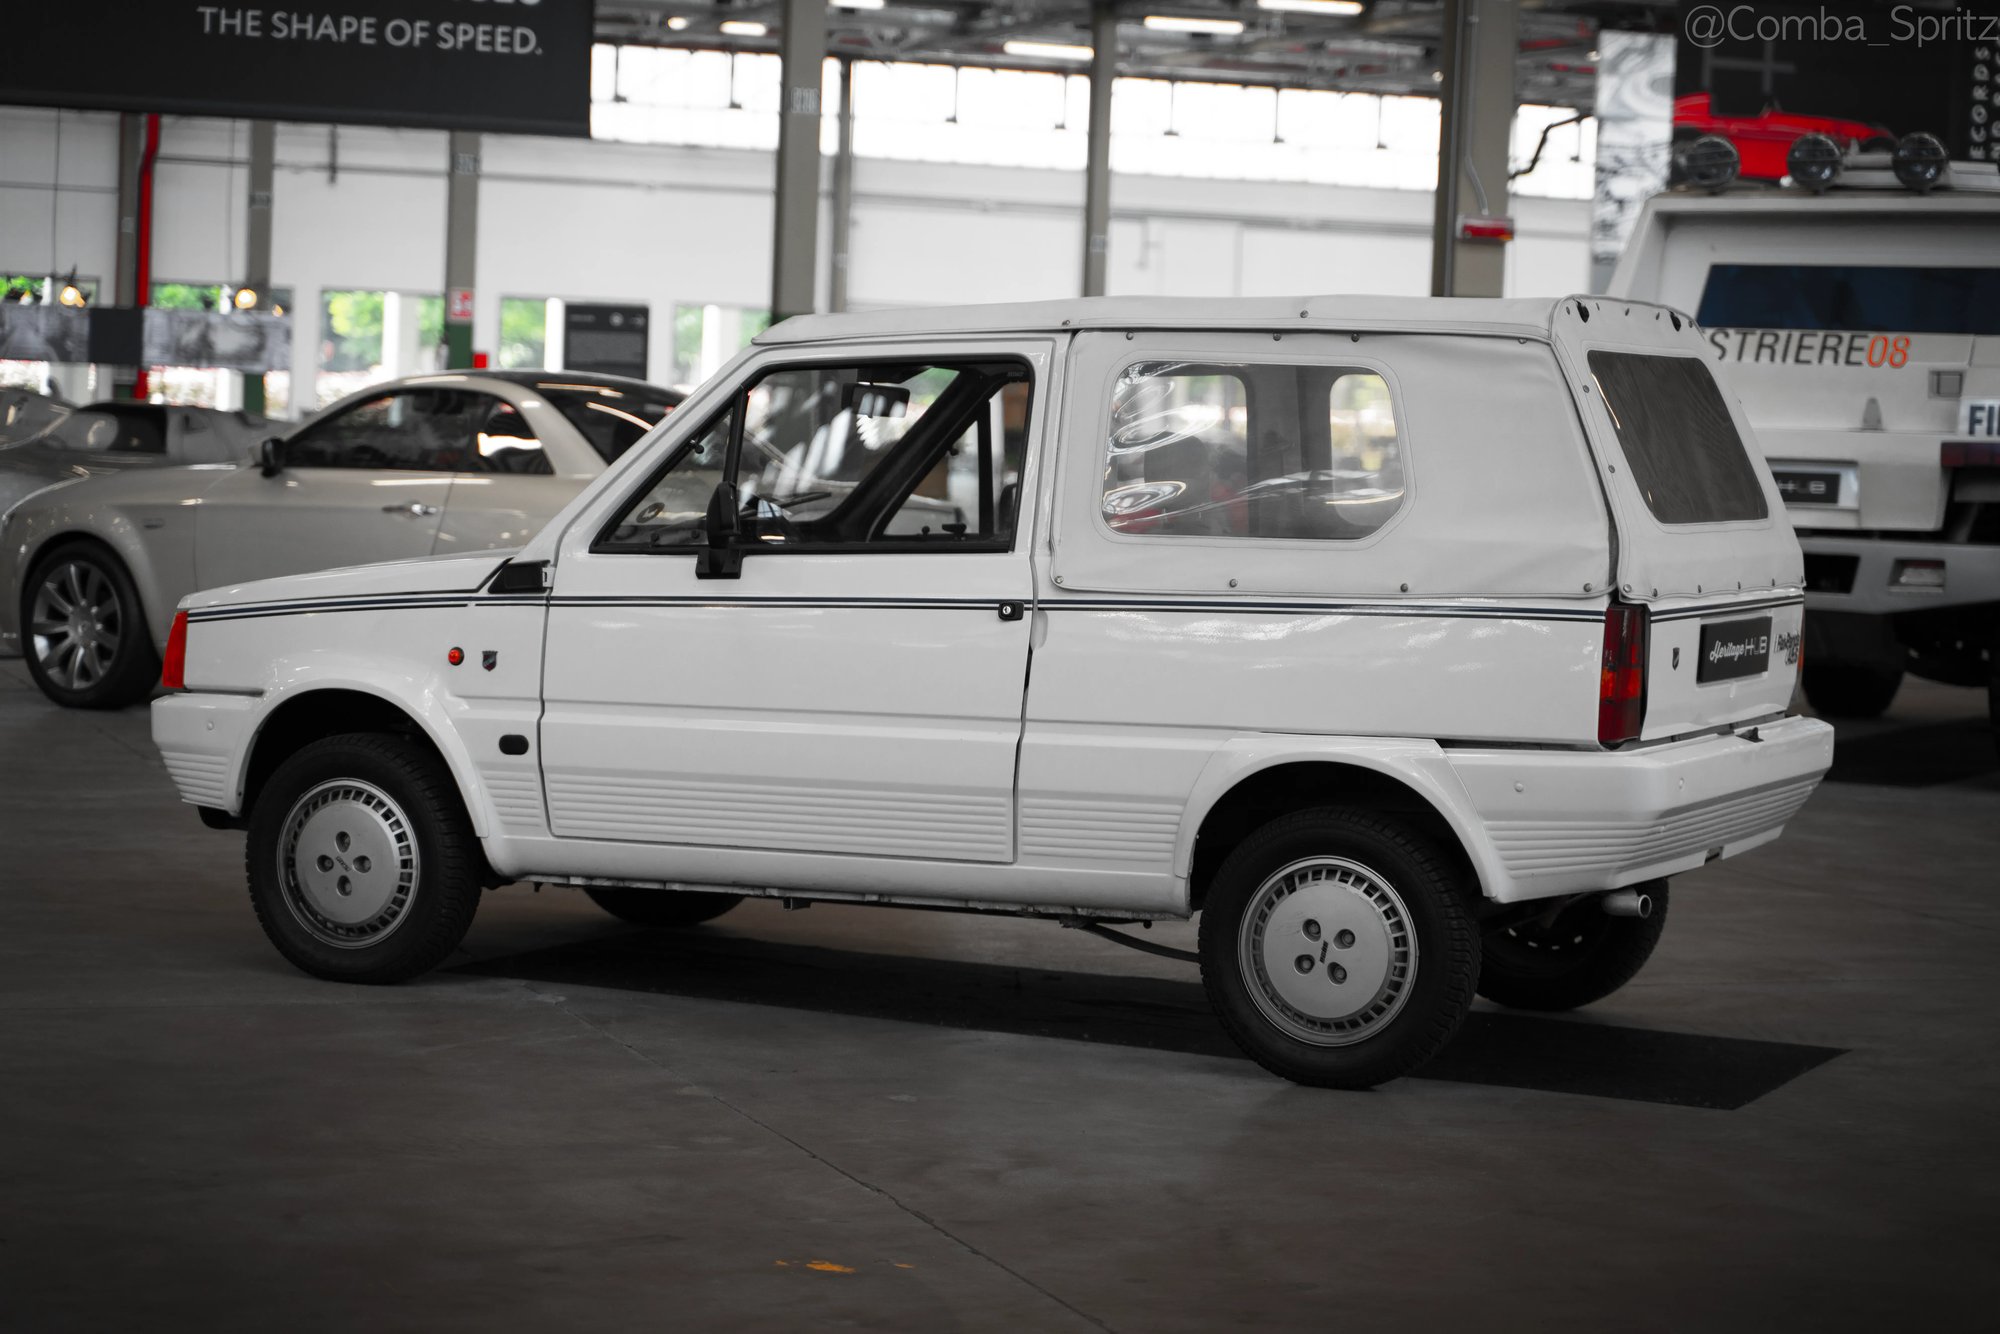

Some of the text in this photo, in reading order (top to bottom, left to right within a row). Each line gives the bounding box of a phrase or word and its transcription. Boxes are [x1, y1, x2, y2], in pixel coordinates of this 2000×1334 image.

[197, 6, 543, 56] THE SHAPE OF SPEED.
[1969, 46, 1990, 160] ECORDS
[1701, 328, 1911, 369] STRIERE08
[1968, 405, 2000, 437] FI
